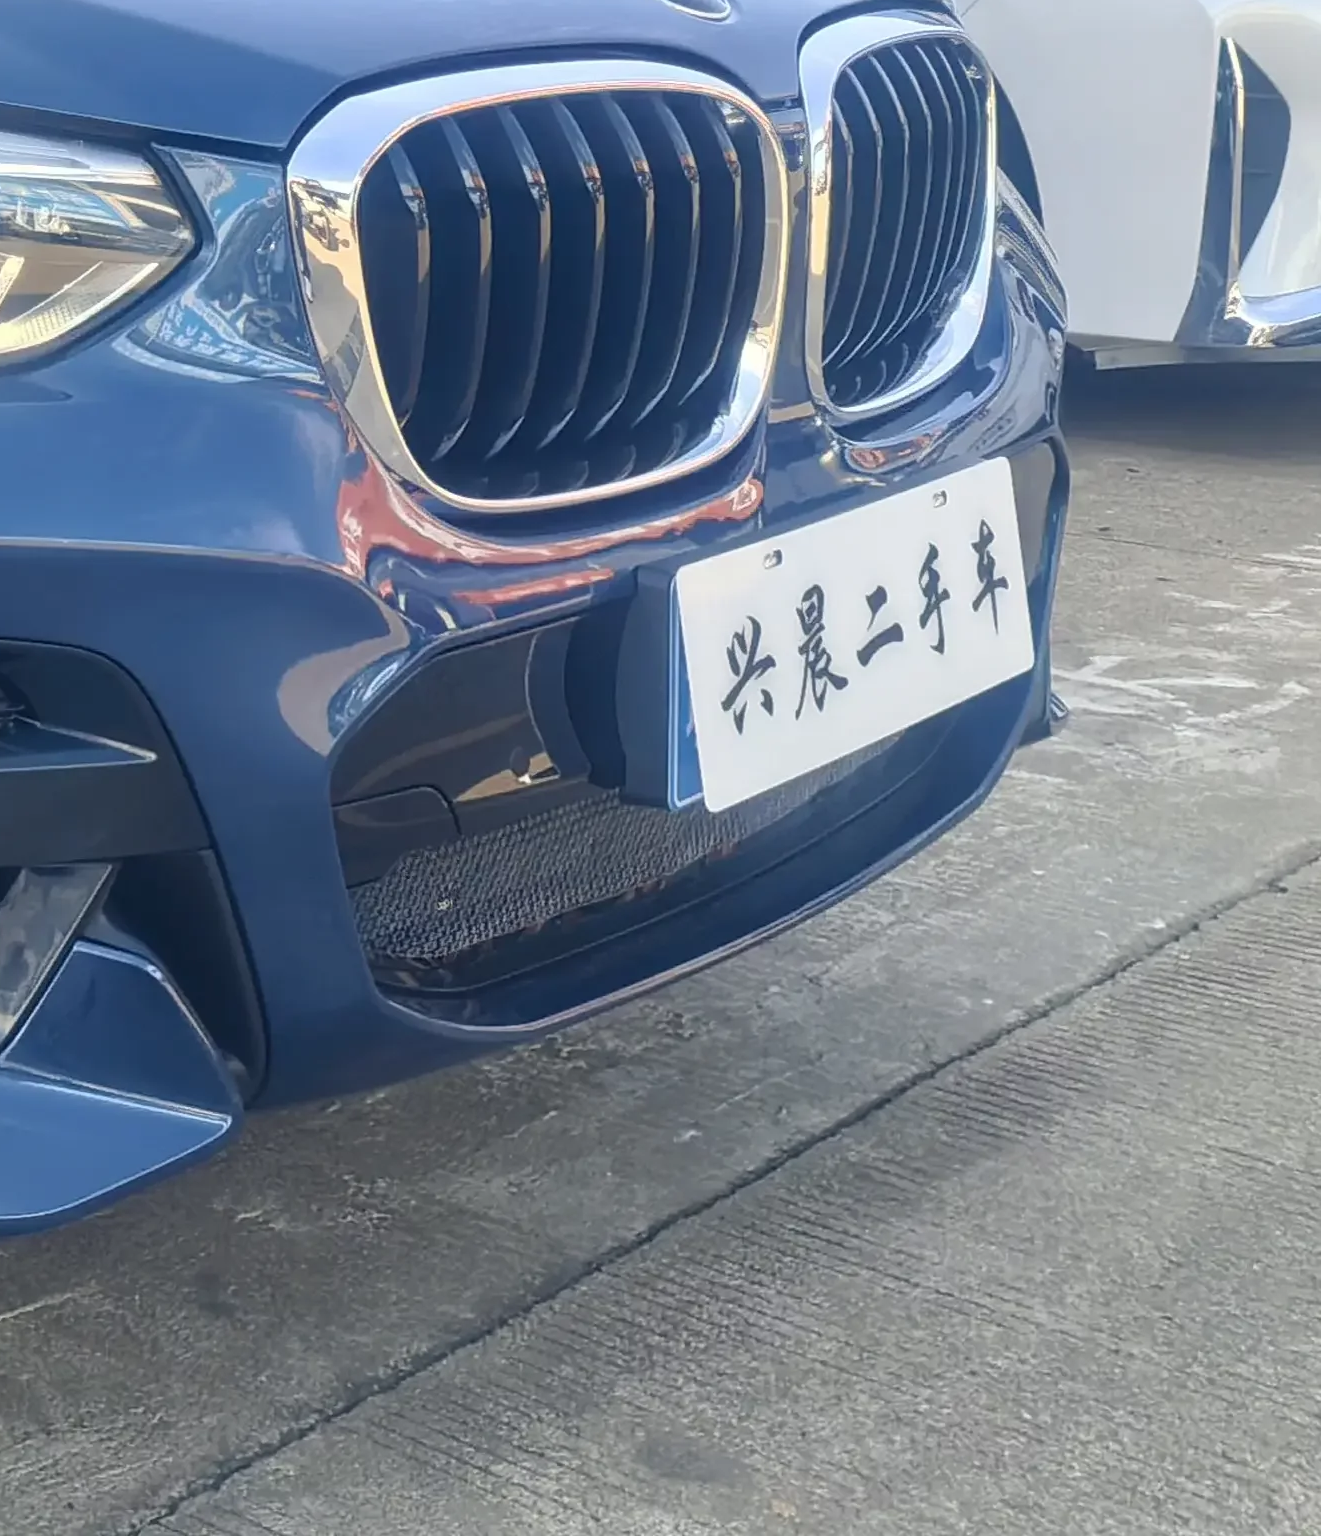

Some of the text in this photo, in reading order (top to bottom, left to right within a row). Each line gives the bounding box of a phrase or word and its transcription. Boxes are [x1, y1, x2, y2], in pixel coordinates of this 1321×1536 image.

[720, 517, 1011, 736] 兴晨二手车
